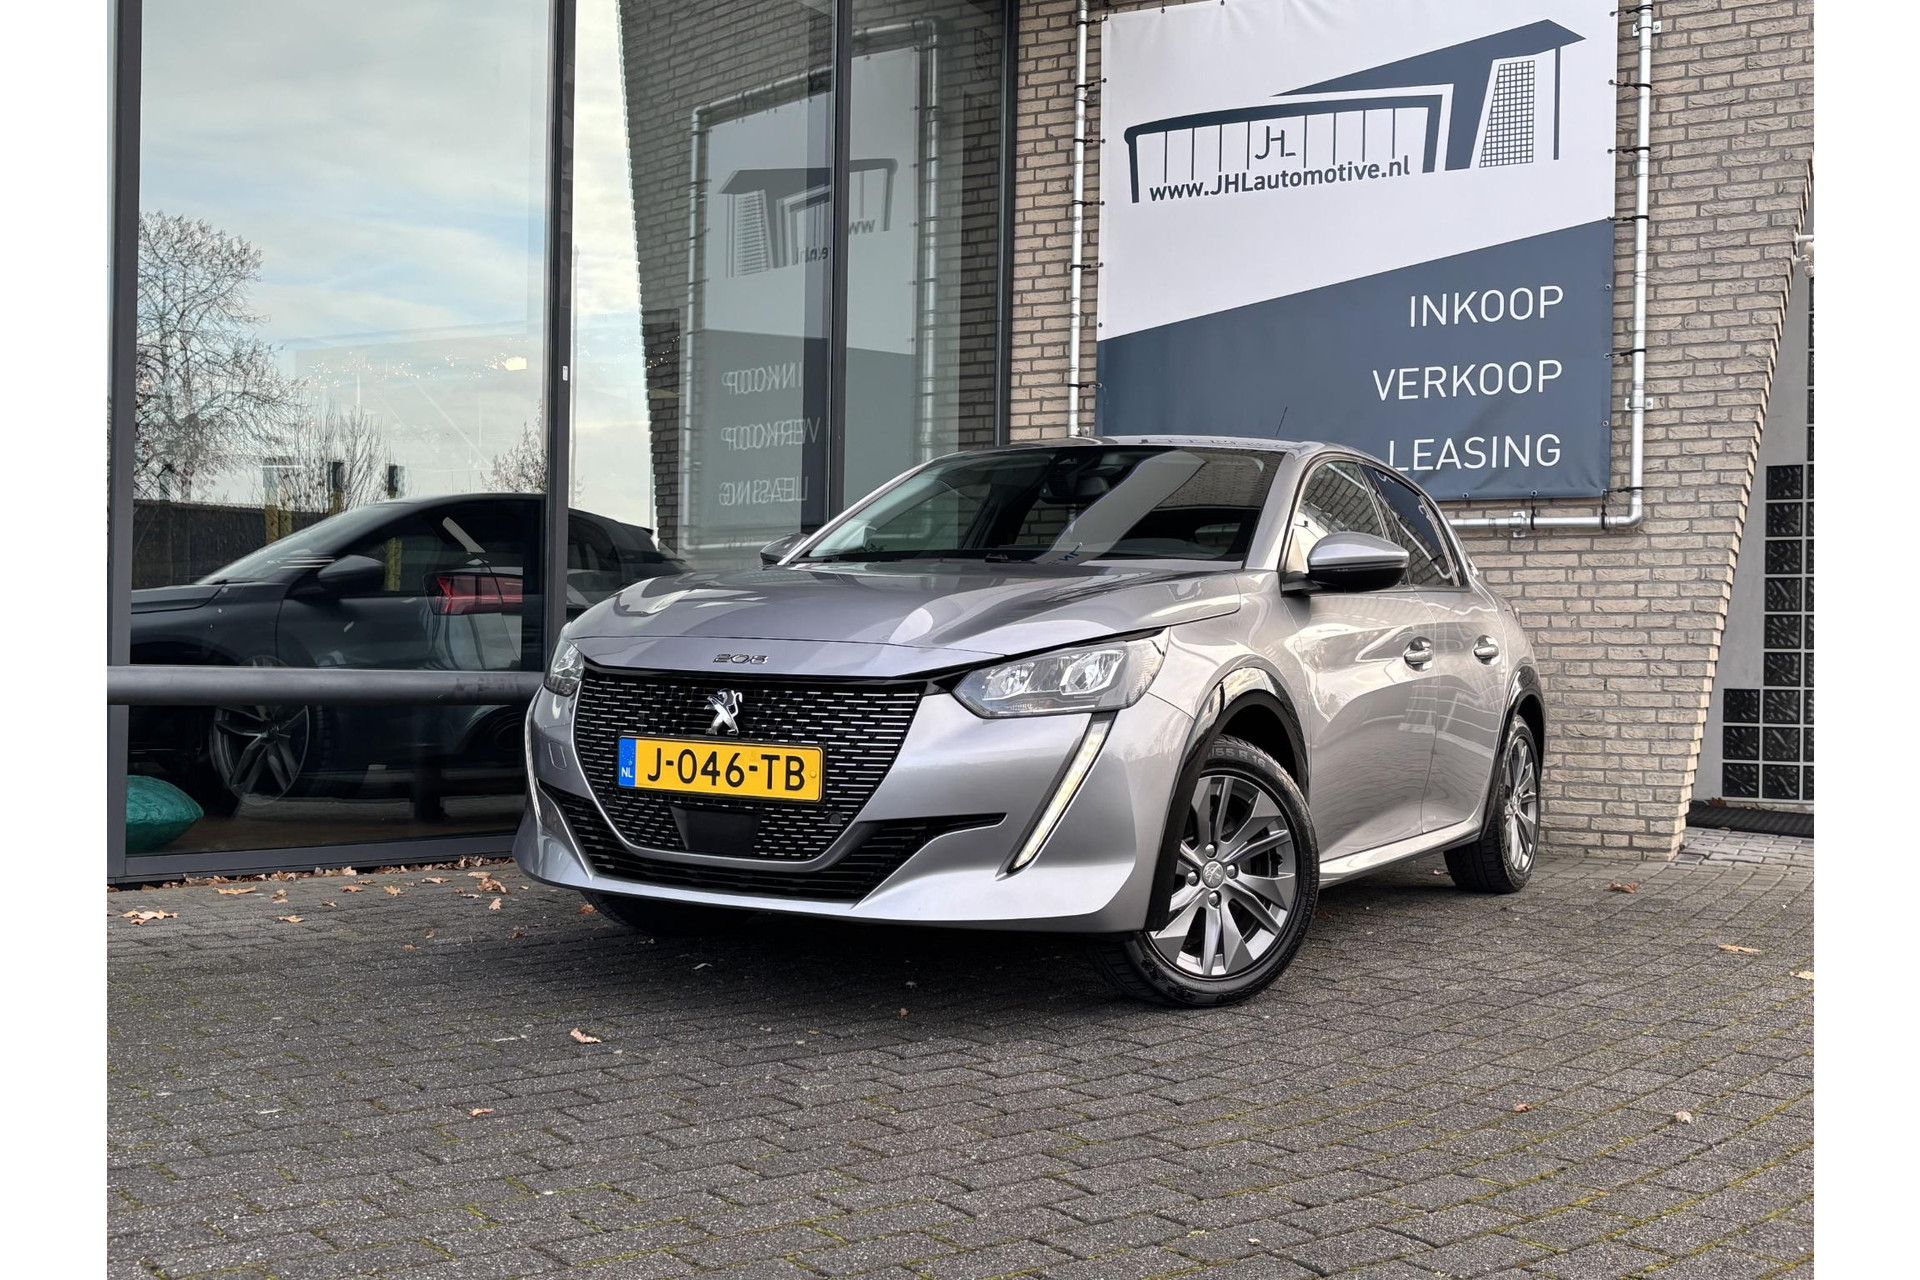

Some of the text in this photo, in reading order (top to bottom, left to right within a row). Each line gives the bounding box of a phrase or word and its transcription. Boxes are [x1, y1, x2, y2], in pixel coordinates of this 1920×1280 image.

[1254, 125, 1297, 160] JHL
[1149, 155, 1410, 202] www.JHLautomotive.nl
[1410, 285, 1564, 328] INKOOP
[1372, 359, 1563, 401] VERKOOP
[1388, 433, 1561, 471] LEASING
[712, 653, 769, 665] 208
[621, 767, 634, 779] NL
[647, 747, 806, 791] J-046-TB
